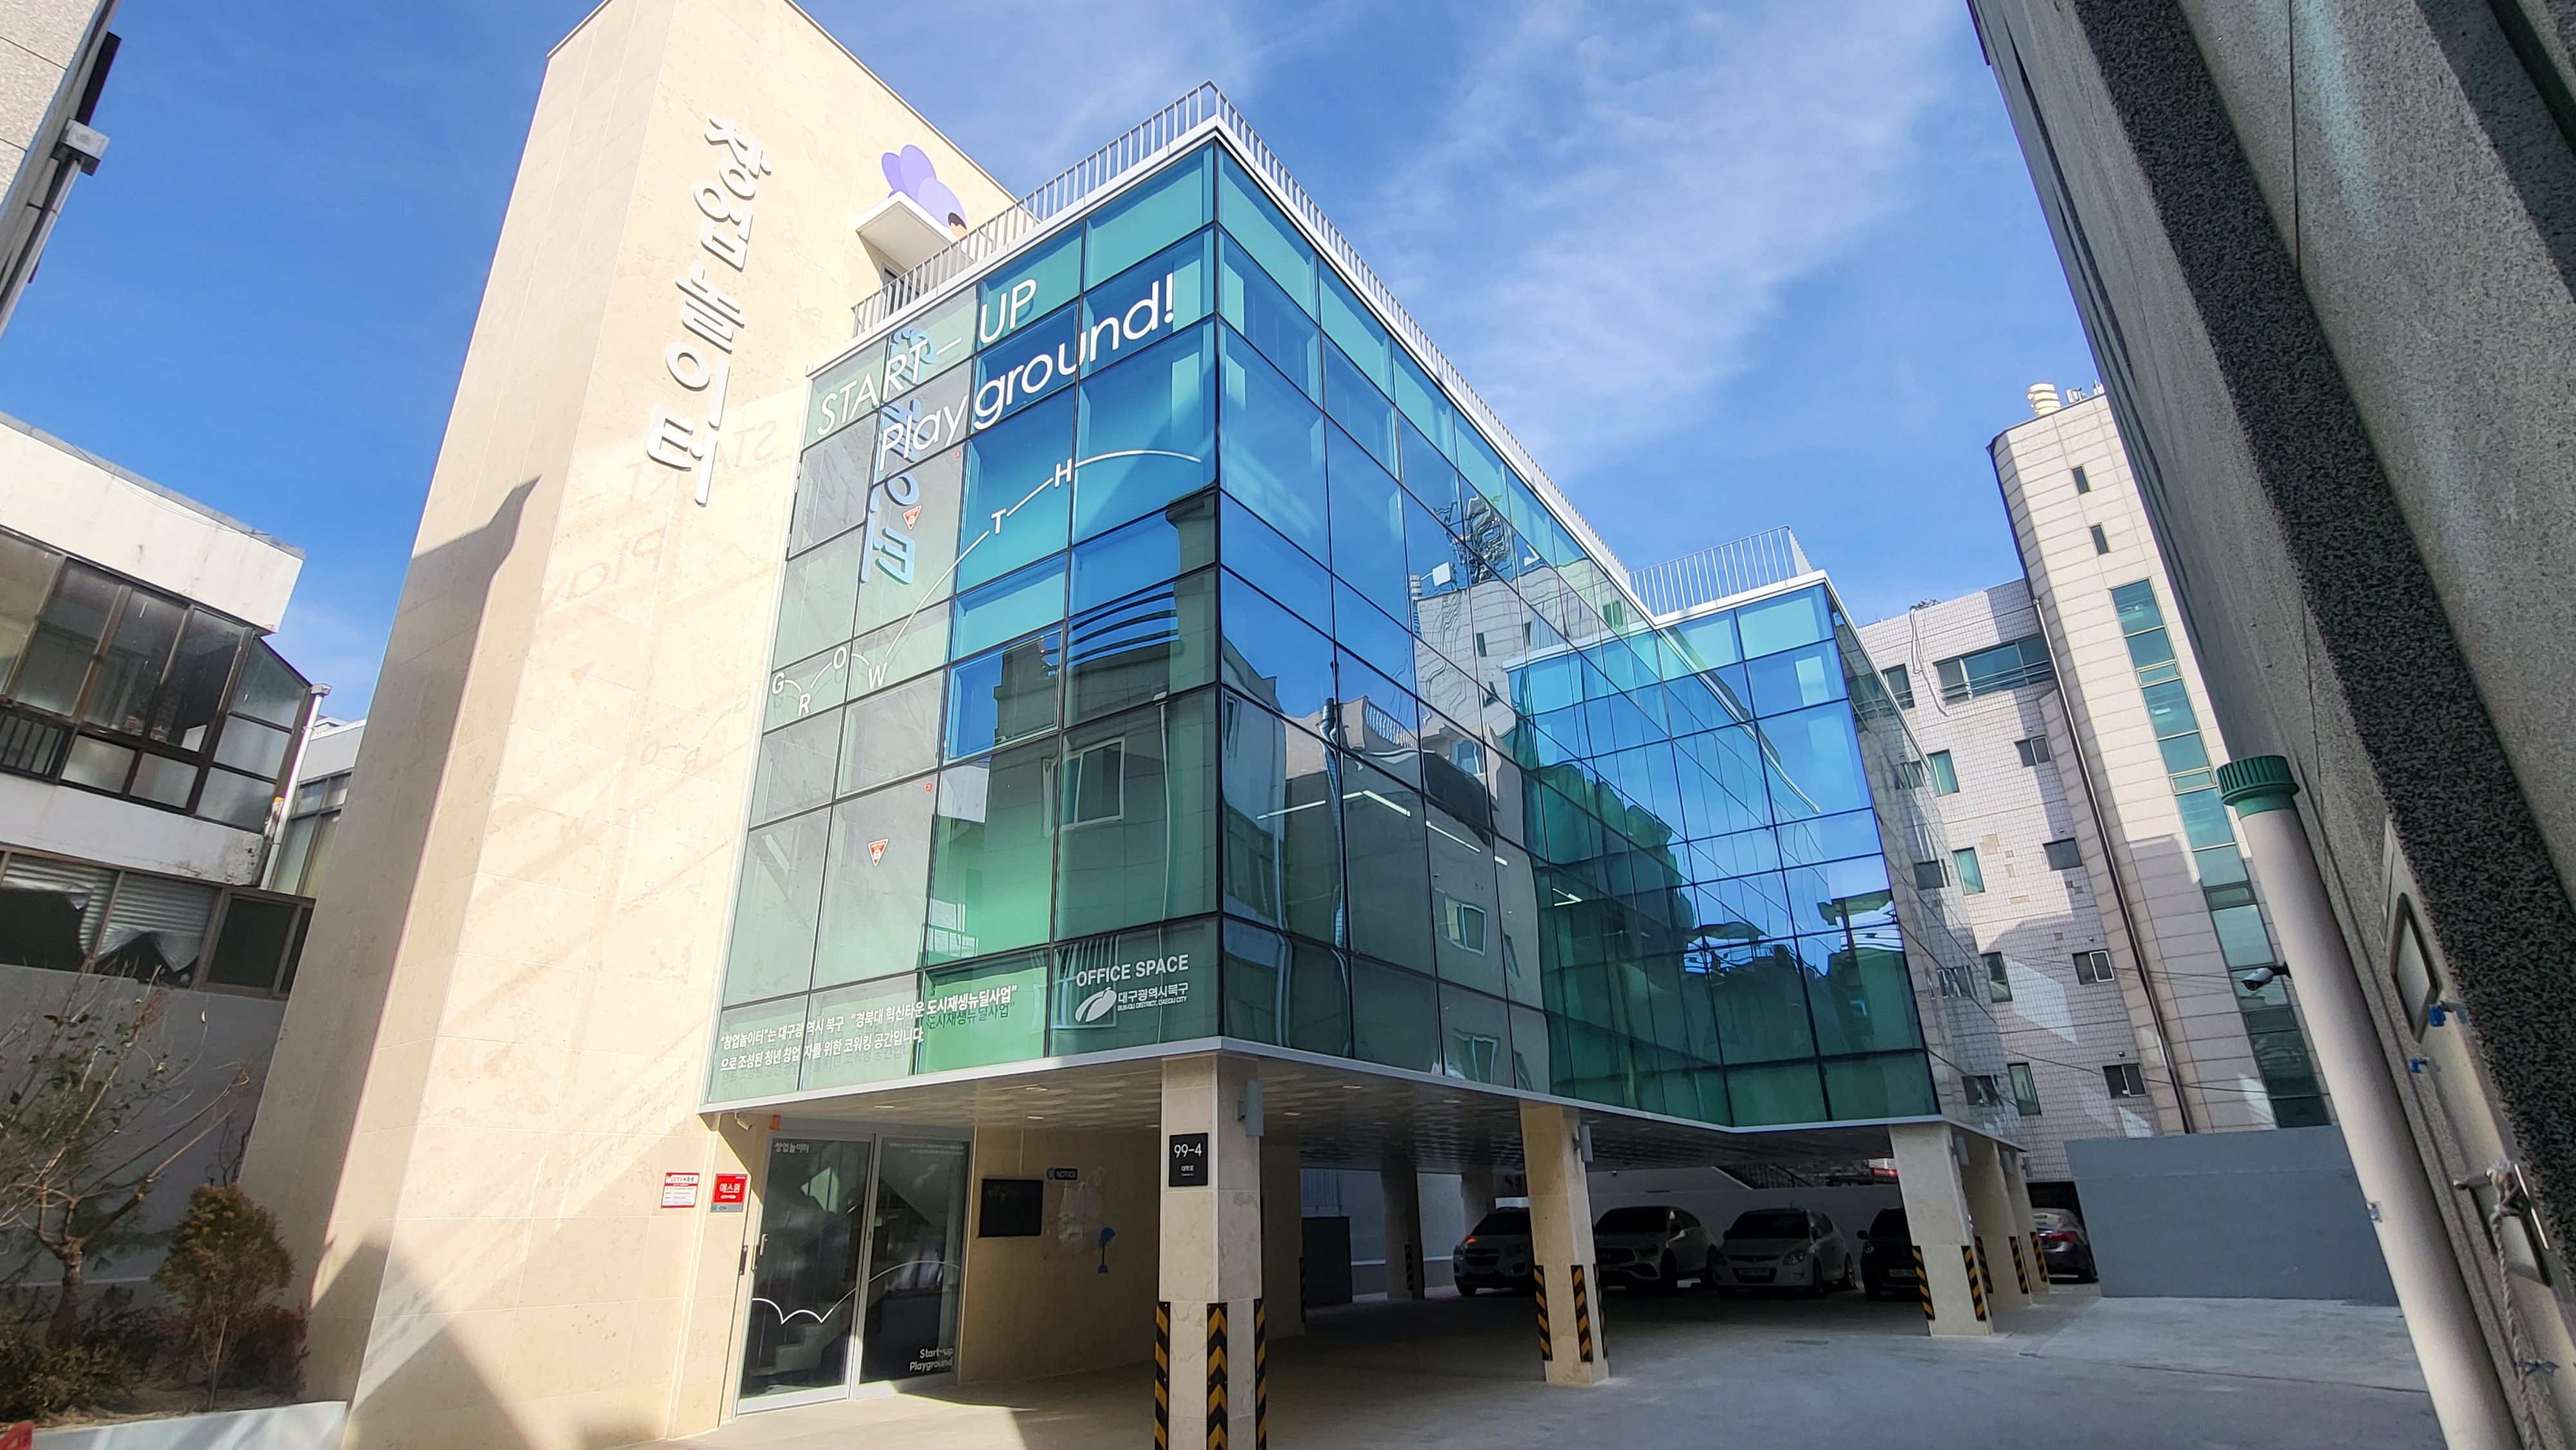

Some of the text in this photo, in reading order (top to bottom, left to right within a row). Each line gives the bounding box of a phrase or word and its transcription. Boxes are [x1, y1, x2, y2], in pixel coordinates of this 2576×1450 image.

[647, 116, 772, 506] 창업놀이터
[980, 279, 1037, 346] UP
[1076, 954, 1189, 987] OFFICE SPACE
[826, 1015, 844, 1033] 북구
[886, 1002, 925, 1022] 혁신타운
[720, 1057, 737, 1071] 으로
[737, 1051, 763, 1069] 조성된
[764, 1048, 781, 1066] 청년
[823, 1039, 842, 1057] 위한
[844, 1032, 871, 1053] 코워킹
[1174, 1143, 1202, 1158] 99-4
[909, 1356, 953, 1372] Playground
[920, 1347, 953, 1359] Start-up
